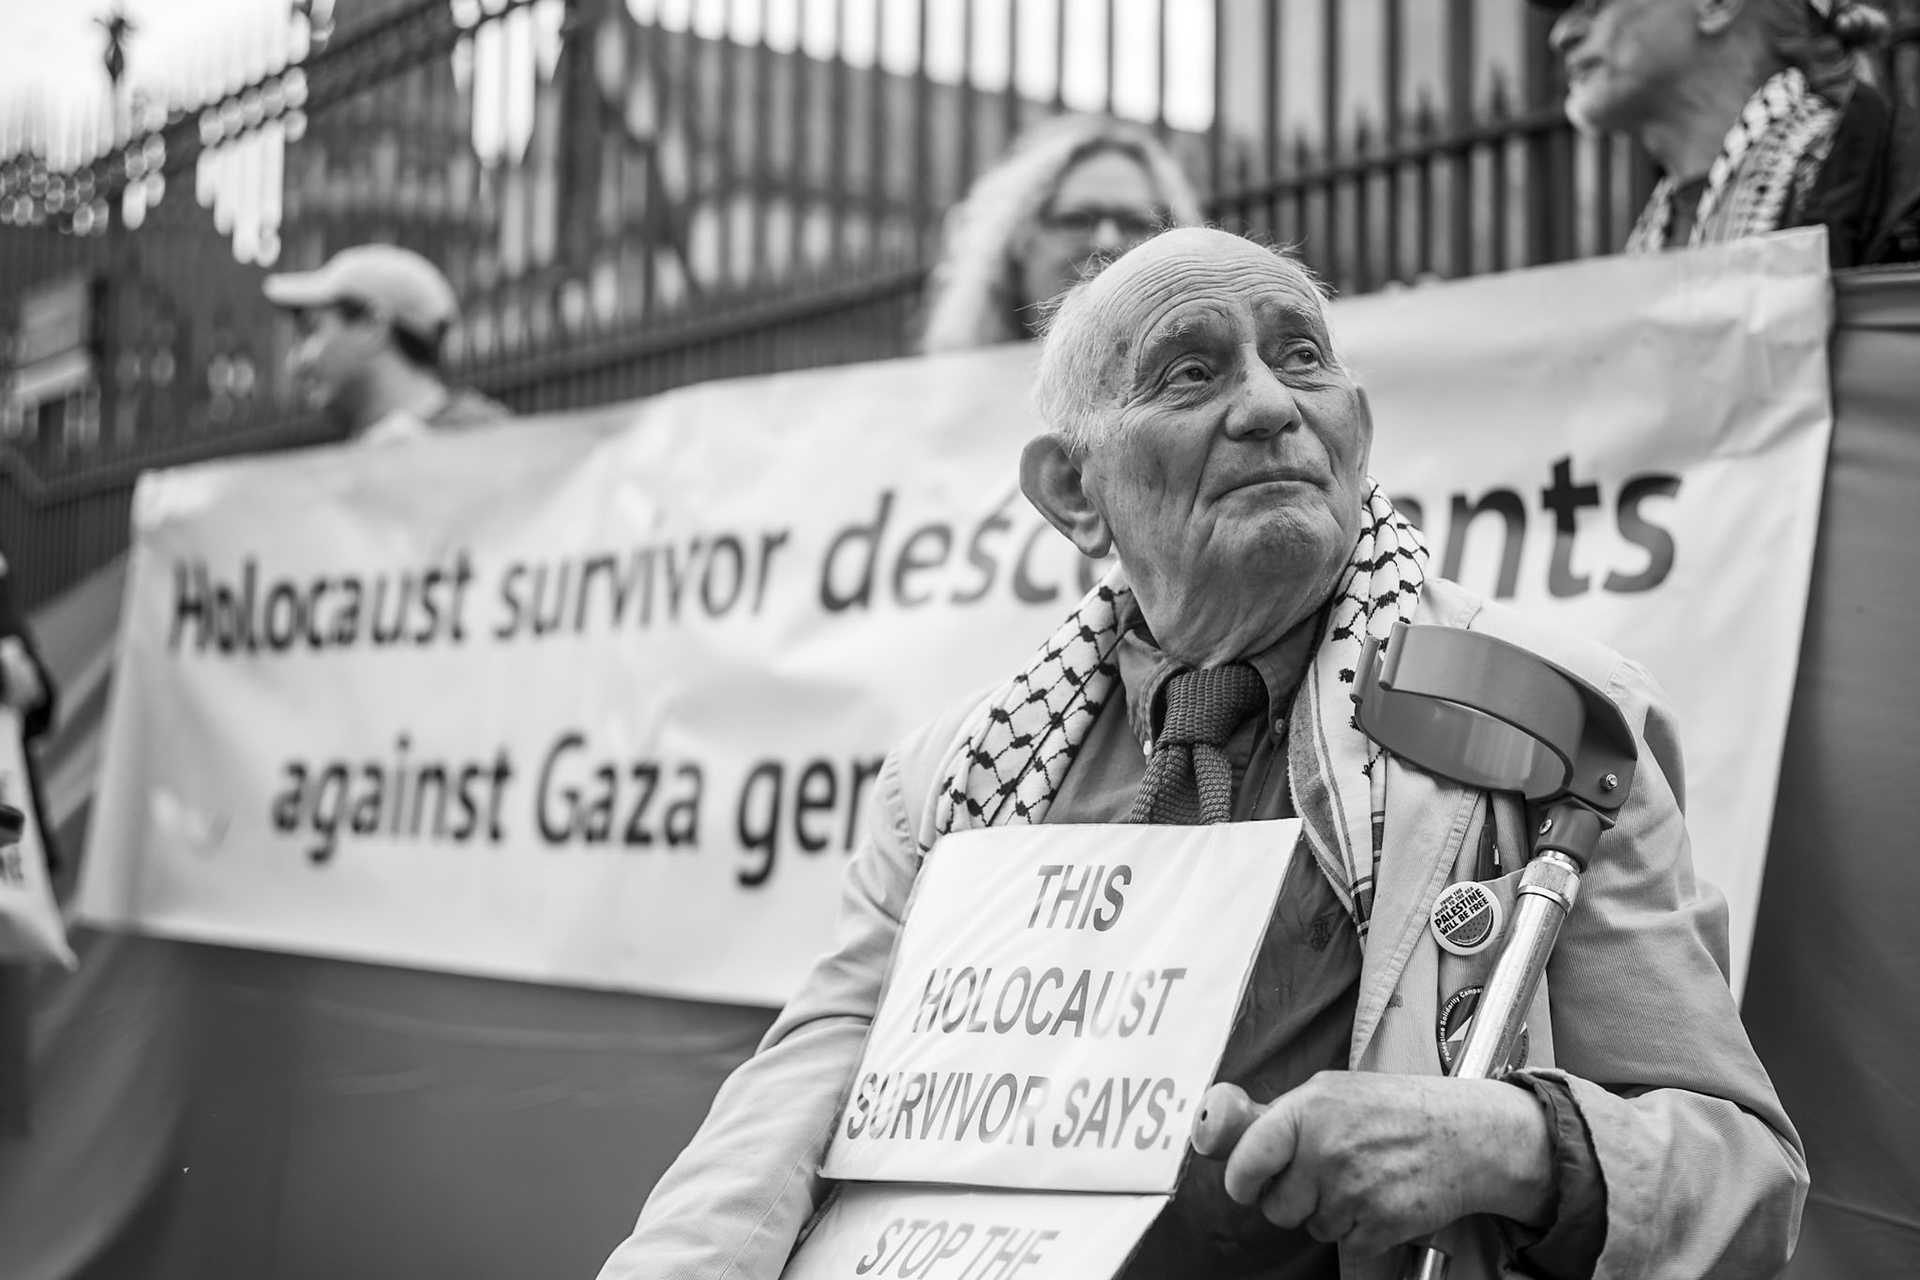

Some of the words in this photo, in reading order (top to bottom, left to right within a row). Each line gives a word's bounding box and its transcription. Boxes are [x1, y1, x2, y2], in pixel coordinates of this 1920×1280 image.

[168, 552, 472, 656] Holocaust
[496, 526, 788, 634] survivor
[272, 734, 514, 866] against
[535, 734, 706, 850] Gaza
[1027, 864, 1132, 932] THIS
[1434, 905, 1449, 918] RIVER
[1455, 893, 1465, 902] THE
[1464, 886, 1475, 895] SEA
[1434, 888, 1484, 929] PALESTINE
[1439, 920, 1460, 936] WILL
[1457, 910, 1471, 923] BE
[1469, 896, 1490, 915] FREE
[1440, 895, 1453, 907] FROM
[1453, 888, 1463, 897] THE
[912, 966, 1187, 1038] HOLOCAUST
[1440, 996, 1460, 1026] Solidarity
[1459, 987, 1484, 998] Campai
[1440, 1027, 1452, 1062] Palestine
[846, 1072, 1050, 1147] SURVIVOR
[1052, 1077, 1187, 1150] SAYS:
[856, 1218, 976, 1280] STOP
